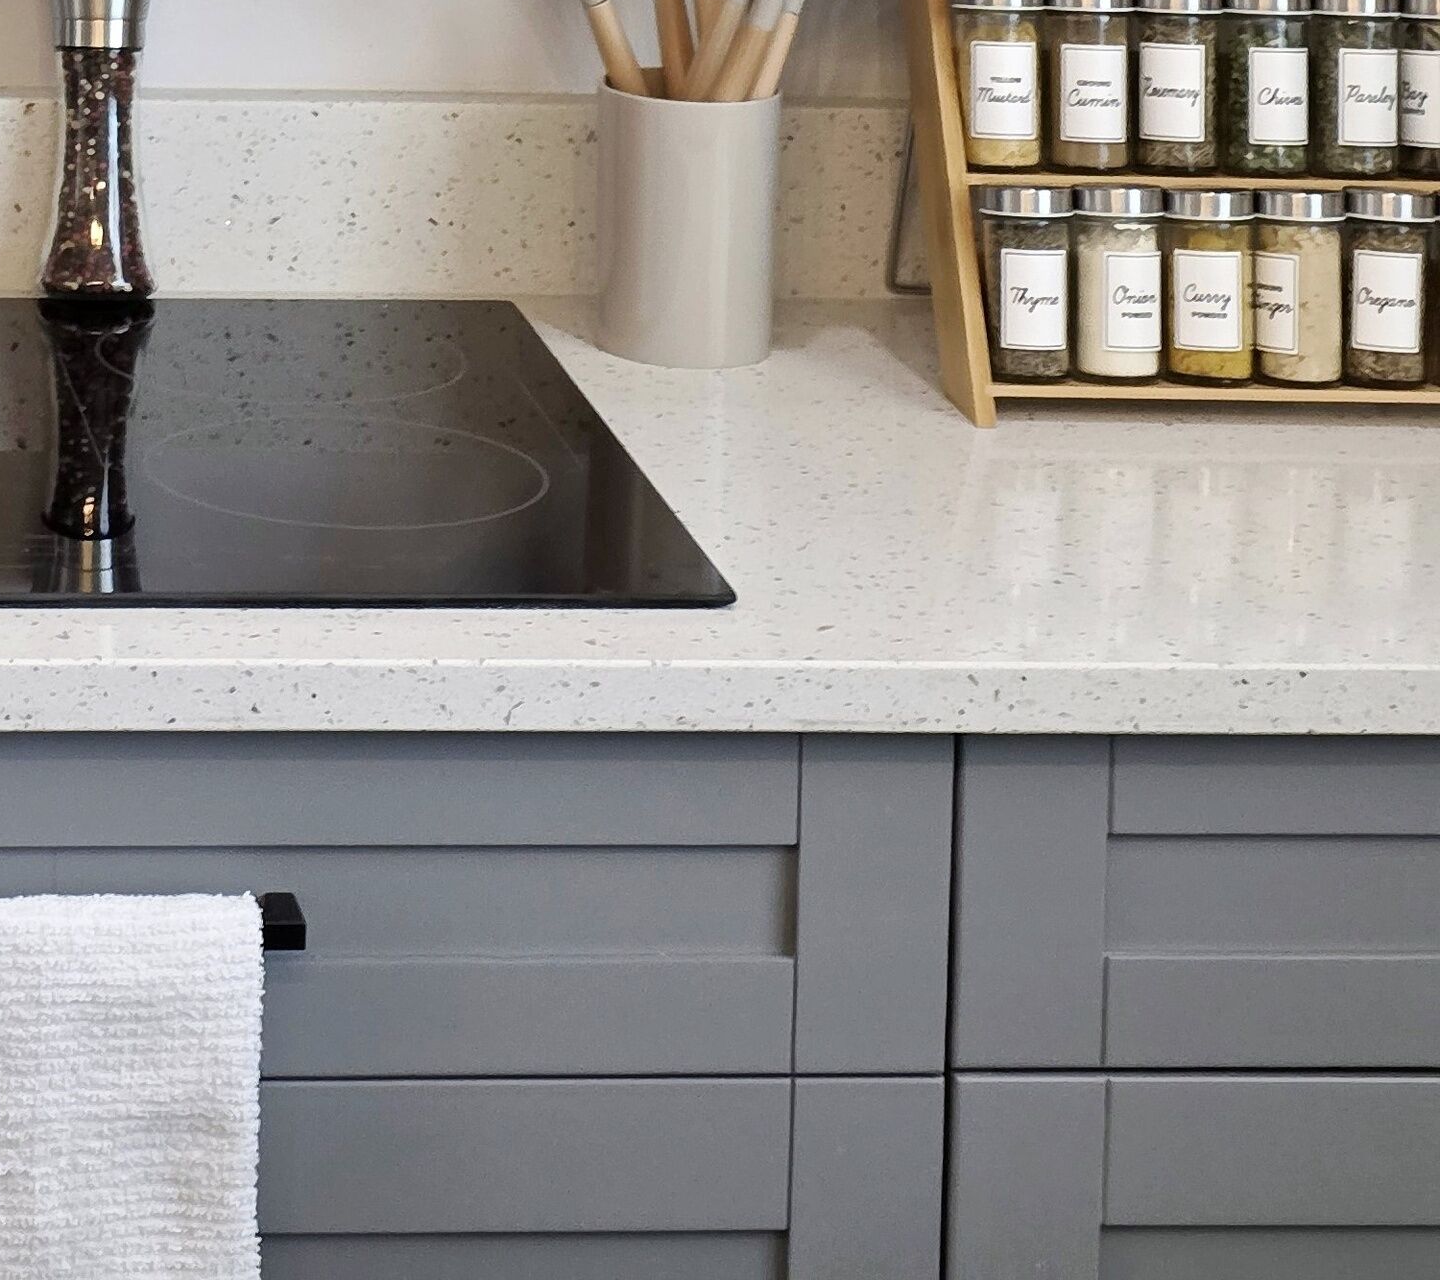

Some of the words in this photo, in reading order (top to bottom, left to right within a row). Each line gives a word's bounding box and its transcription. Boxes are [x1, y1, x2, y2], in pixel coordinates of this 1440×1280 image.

[1068, 88, 1121, 108] Cumin
[1258, 86, 1304, 106] Chives
[1345, 84, 1396, 112] Parsley
[1010, 286, 1060, 313] Thyme
[1112, 284, 1157, 305] Onion
[1183, 283, 1232, 310] Curry
[1358, 286, 1416, 314] Oregano
